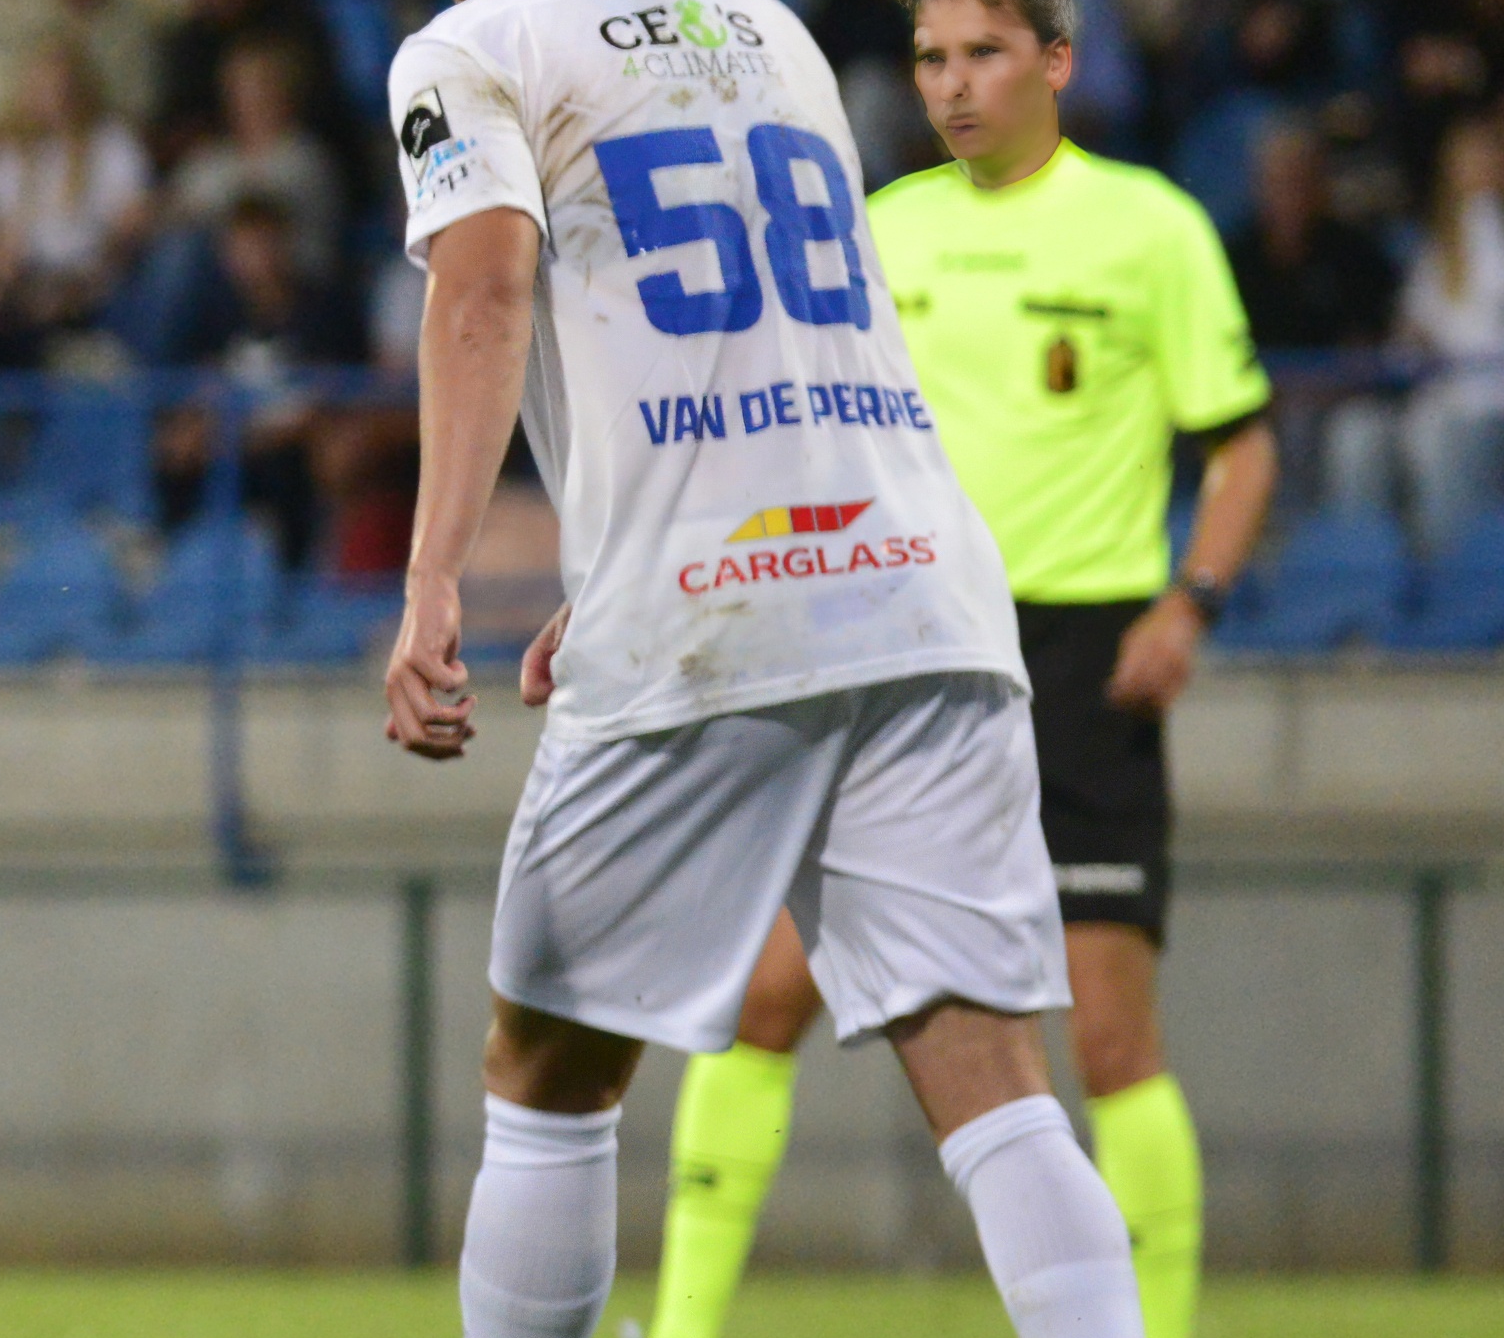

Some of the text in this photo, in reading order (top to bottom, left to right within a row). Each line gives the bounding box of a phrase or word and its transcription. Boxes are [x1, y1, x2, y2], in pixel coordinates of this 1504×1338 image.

[594, 123, 872, 337] 58
[639, 393, 727, 445] VAN
[739, 381, 801, 434] DE
[678, 536, 937, 596] CARGLASS
